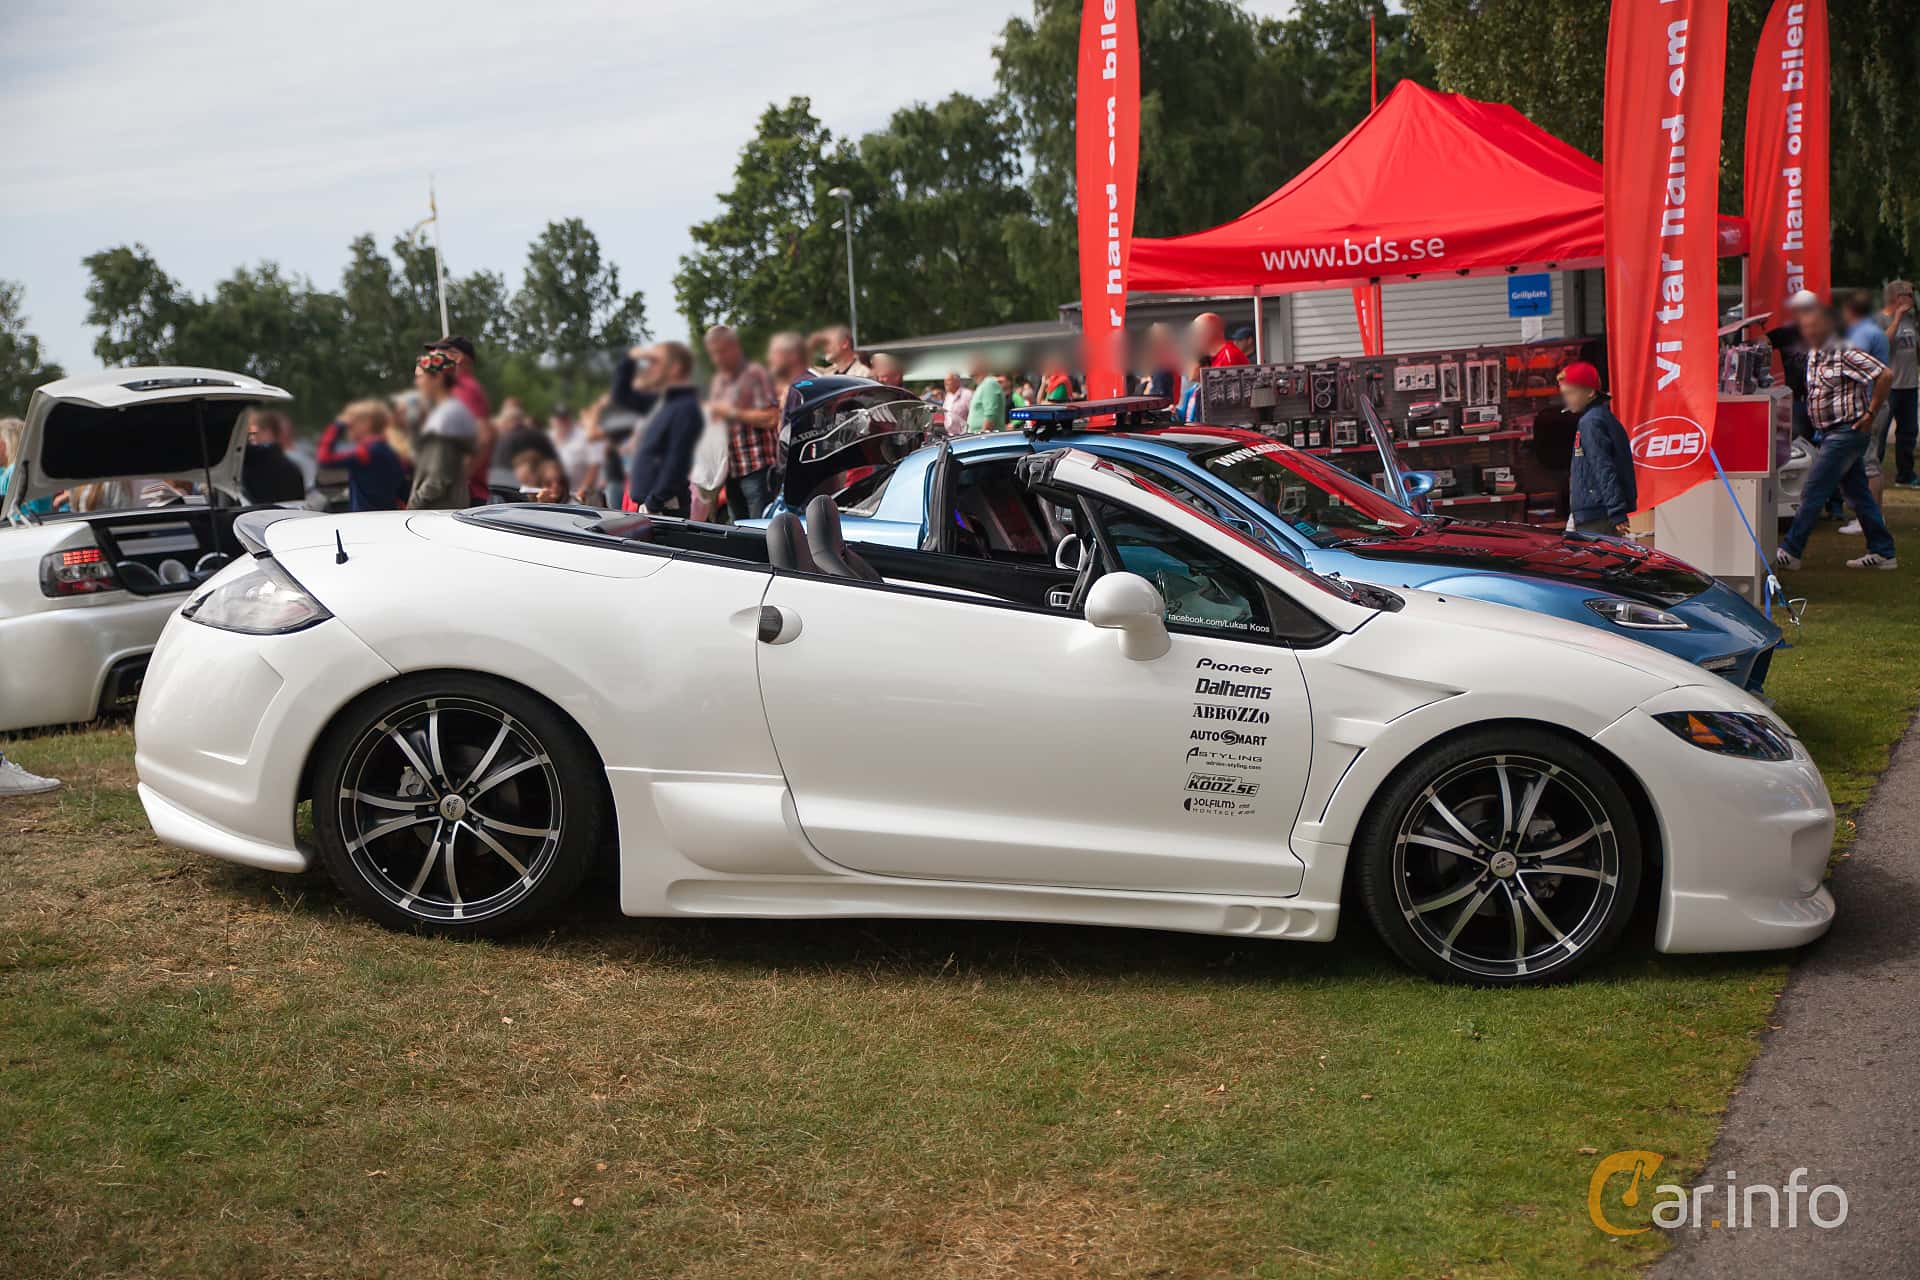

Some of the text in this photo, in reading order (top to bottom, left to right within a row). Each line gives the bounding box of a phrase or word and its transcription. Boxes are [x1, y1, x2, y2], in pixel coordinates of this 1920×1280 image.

[1101, 0, 1117, 80] bile
[1667, 19, 1688, 97] om
[1782, 3, 1805, 296] ar hand om bilen
[1261, 236, 1445, 271] www.bds.se
[1656, 254, 1684, 324] tar
[1656, 340, 1683, 391] vi
[1646, 432, 1700, 457] BDS
[1196, 658, 1272, 675] Pioneer
[1195, 678, 1272, 700] Dalhems
[1188, 779, 1258, 795] KOOZ.SE
